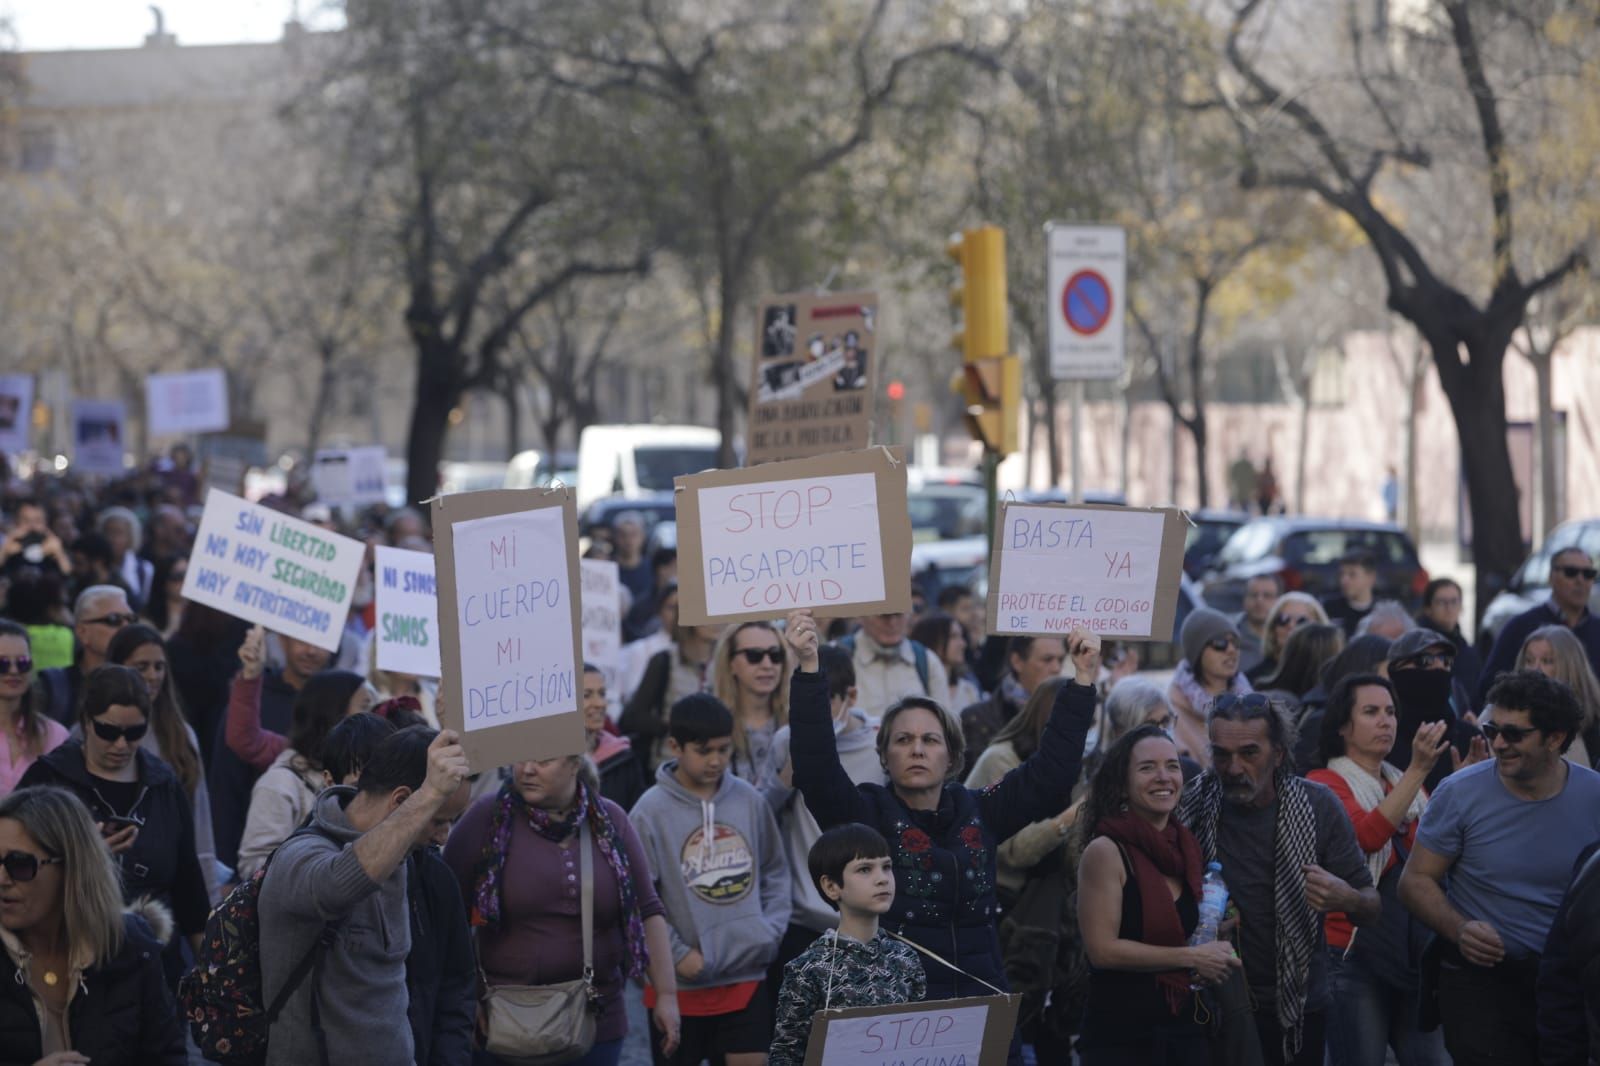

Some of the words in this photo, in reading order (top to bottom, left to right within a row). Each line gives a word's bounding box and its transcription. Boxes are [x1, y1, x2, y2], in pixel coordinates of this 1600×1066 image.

[726, 485, 833, 533] STOP
[269, 520, 336, 562] LIBERTAD
[490, 529, 516, 571] MI
[1012, 518, 1093, 549] BASTA
[205, 532, 229, 559] NO
[272, 557, 346, 604] SEGURIDAD
[383, 566, 397, 589] NI
[709, 542, 867, 587] PASAPORTE
[1104, 551, 1131, 578] YA
[464, 578, 560, 626] CUERPO
[742, 579, 843, 608] COVID
[1001, 593, 1067, 611] PROTEGE
[1070, 595, 1087, 612] EL
[1094, 597, 1149, 613] CODIGO
[382, 612, 429, 647] SOMOS
[1010, 615, 1028, 628] DE
[1044, 617, 1128, 631] NUREMBERG
[497, 637, 521, 666] MI
[860, 1015, 954, 1054] STOP
